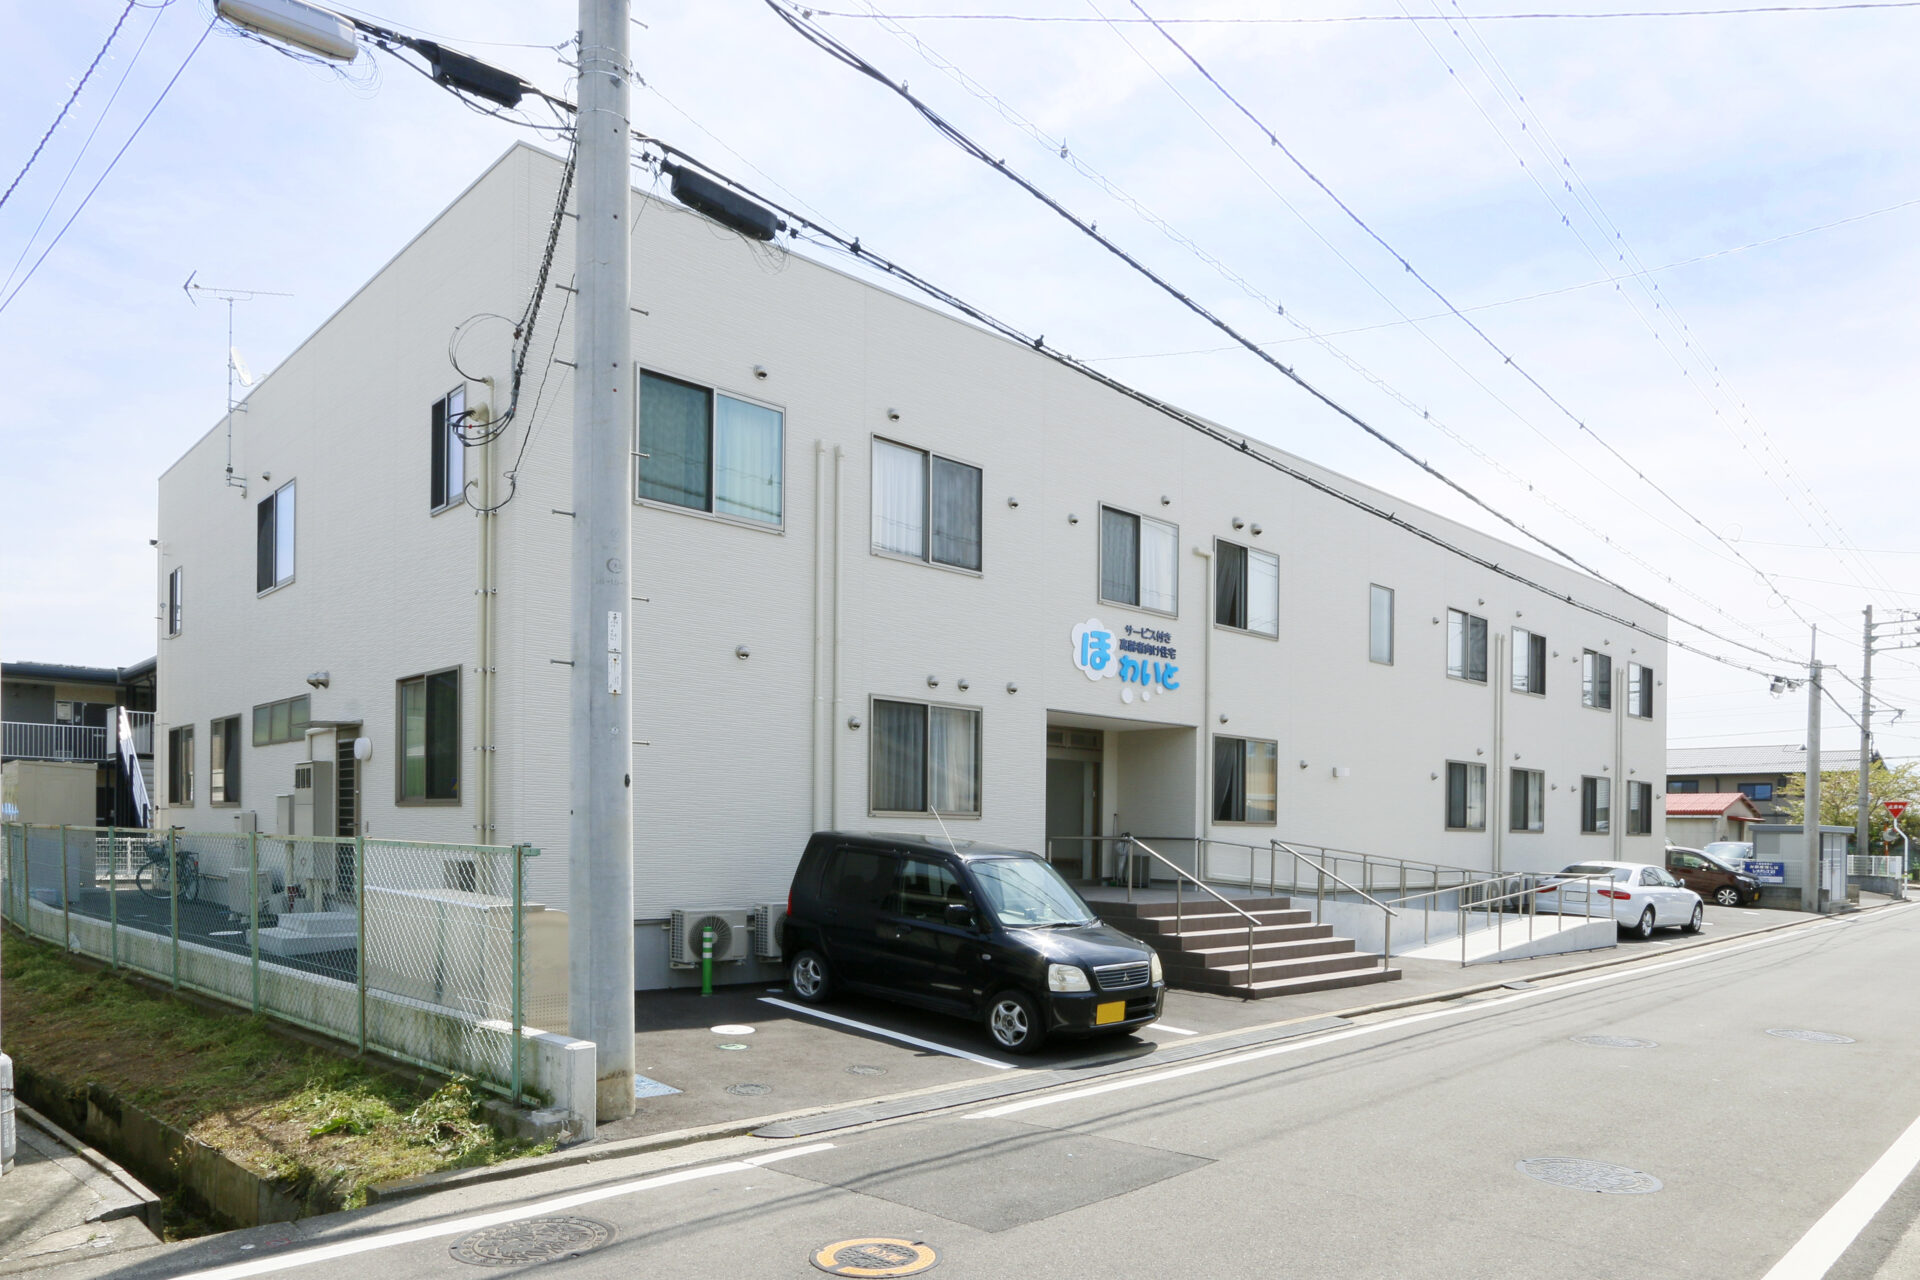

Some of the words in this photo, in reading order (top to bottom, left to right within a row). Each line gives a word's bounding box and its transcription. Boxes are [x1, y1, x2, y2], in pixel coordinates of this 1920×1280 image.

[1124, 625, 1172, 644] サービス付き
